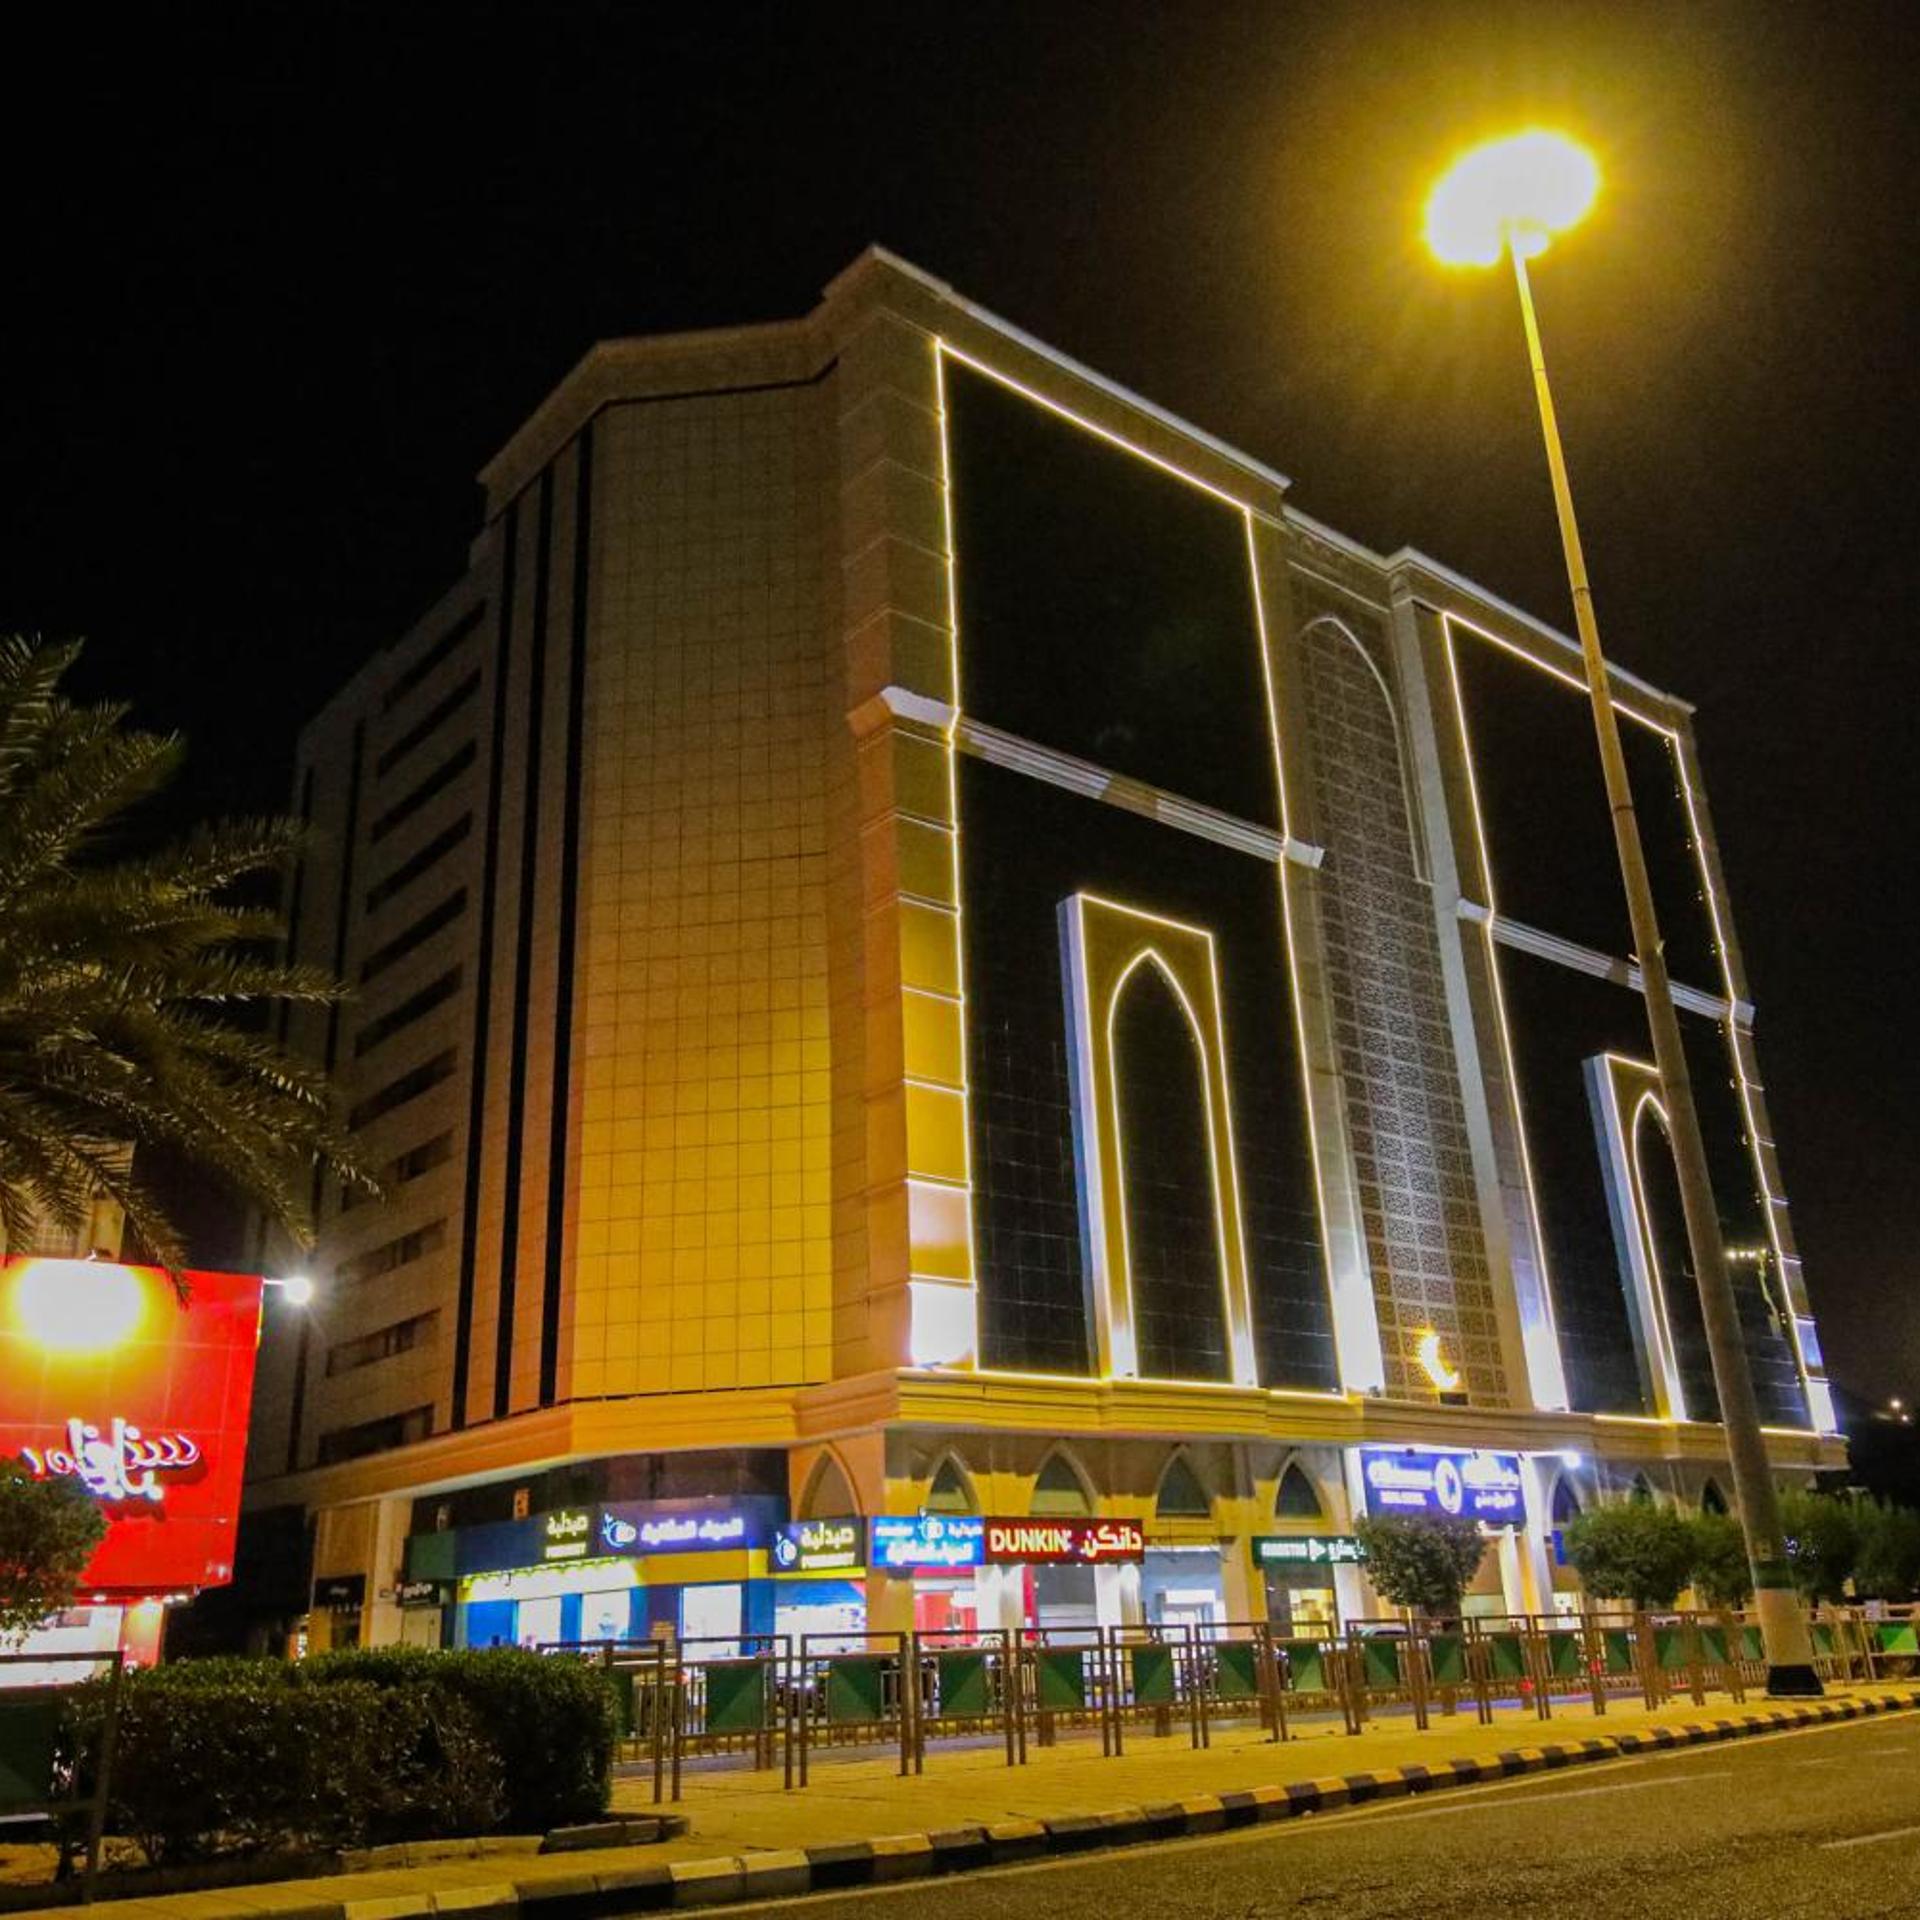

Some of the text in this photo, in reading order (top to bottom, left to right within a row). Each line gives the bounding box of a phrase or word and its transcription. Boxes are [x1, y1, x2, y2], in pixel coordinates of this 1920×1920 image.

[547, 1511, 589, 1539] صيدلية
[801, 1521, 855, 1551] صيدلية
[1083, 1525, 1143, 1558] دانكن
